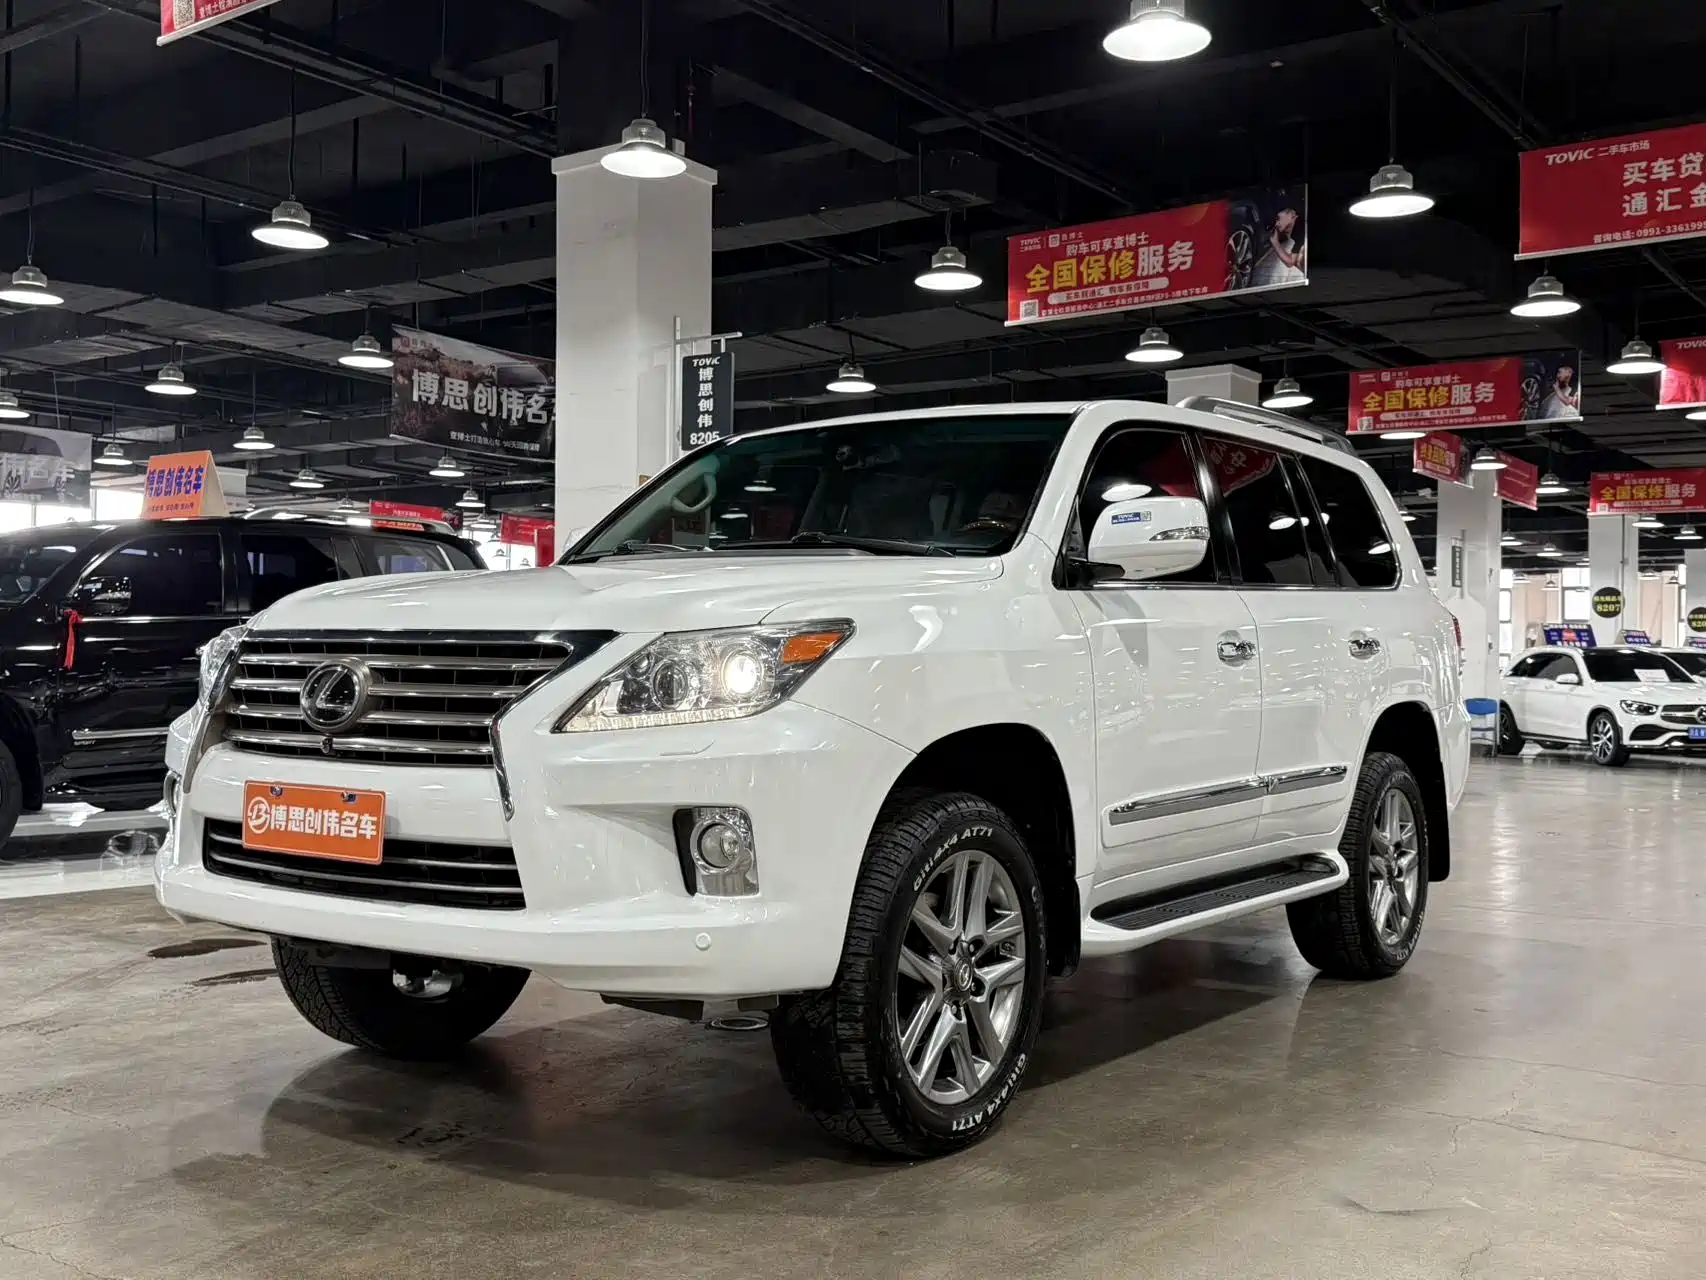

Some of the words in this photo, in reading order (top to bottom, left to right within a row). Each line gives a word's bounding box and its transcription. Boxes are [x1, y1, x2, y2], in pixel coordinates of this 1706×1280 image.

[1545, 147, 1595, 166] TOVIC
[1597, 139, 1651, 157] 二手车市场
[1066, 231, 1149, 256] 购车可享查博士
[1025, 240, 1195, 294] 全国保修服务
[692, 356, 720, 367] TOVIC
[412, 368, 556, 425] 博思创伟名
[1362, 381, 1496, 412] 全国保修服务
[689, 431, 720, 445] 8205
[1600, 483, 1696, 501] 全国保修服务
[270, 803, 377, 840] 博思创伟名车
[961, 826, 993, 840] AT71
